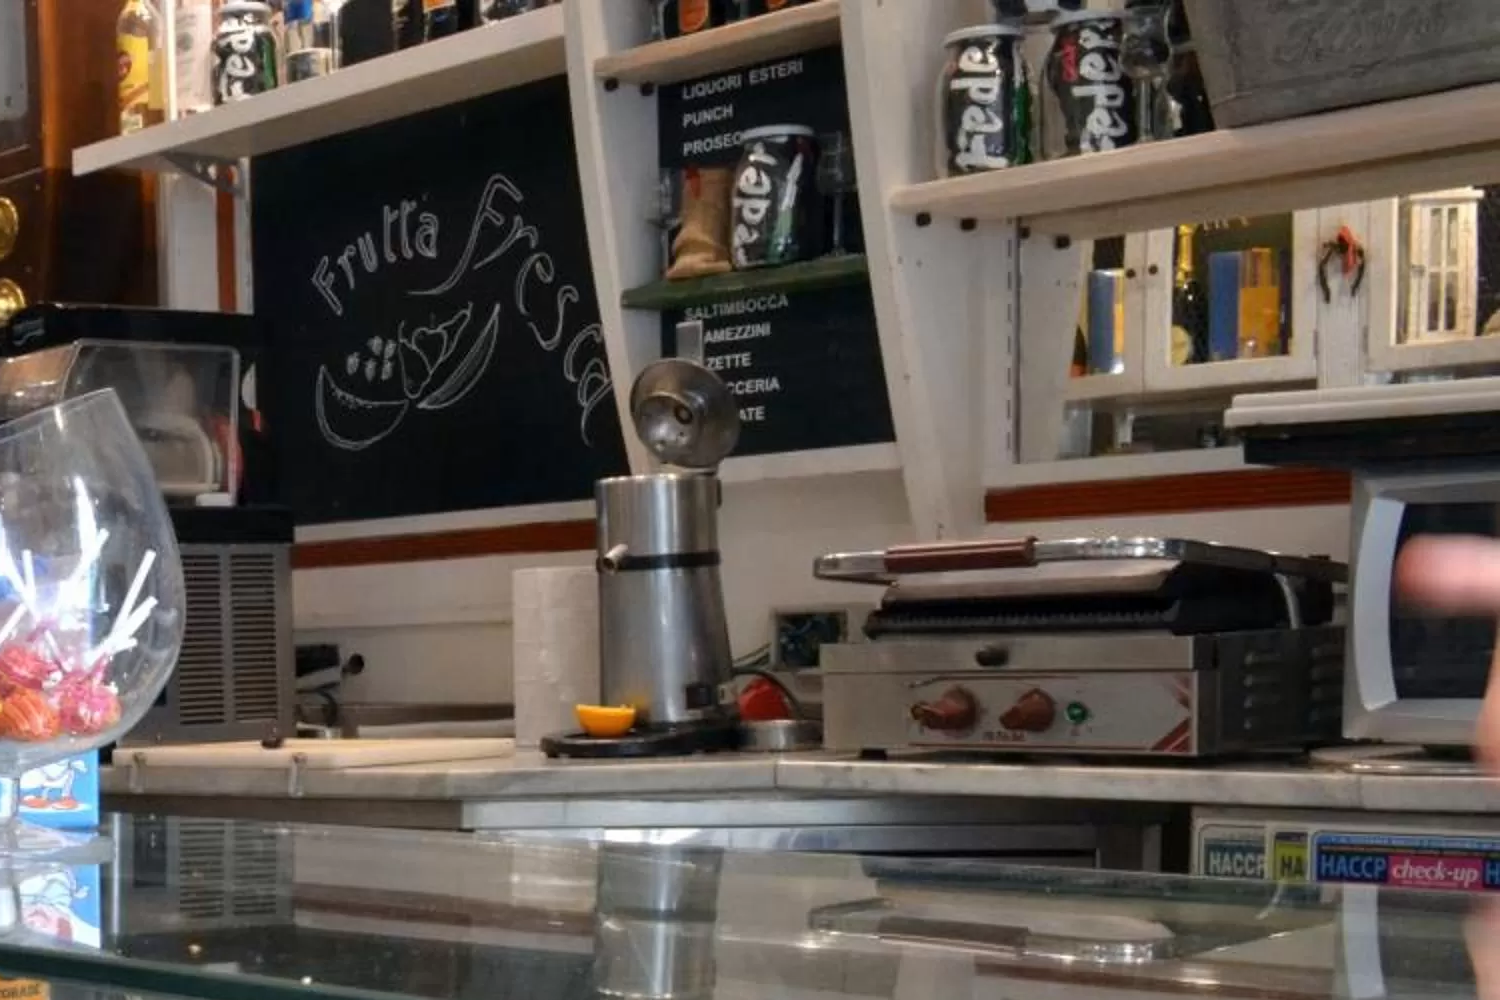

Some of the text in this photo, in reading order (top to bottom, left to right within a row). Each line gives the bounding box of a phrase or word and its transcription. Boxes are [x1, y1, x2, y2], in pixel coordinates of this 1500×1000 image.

[682, 58, 804, 100] LIQUORI ESTERI
[682, 103, 734, 128] PUNCH
[683, 131, 744, 156] PROSEC
[684, 293, 789, 321] SALTIMBOCCA
[704, 322, 772, 344] AMEZZINI
[707, 352, 752, 371] ZETTE
[1321, 853, 1386, 879] HACCP
[1392, 860, 1479, 888] check-up
